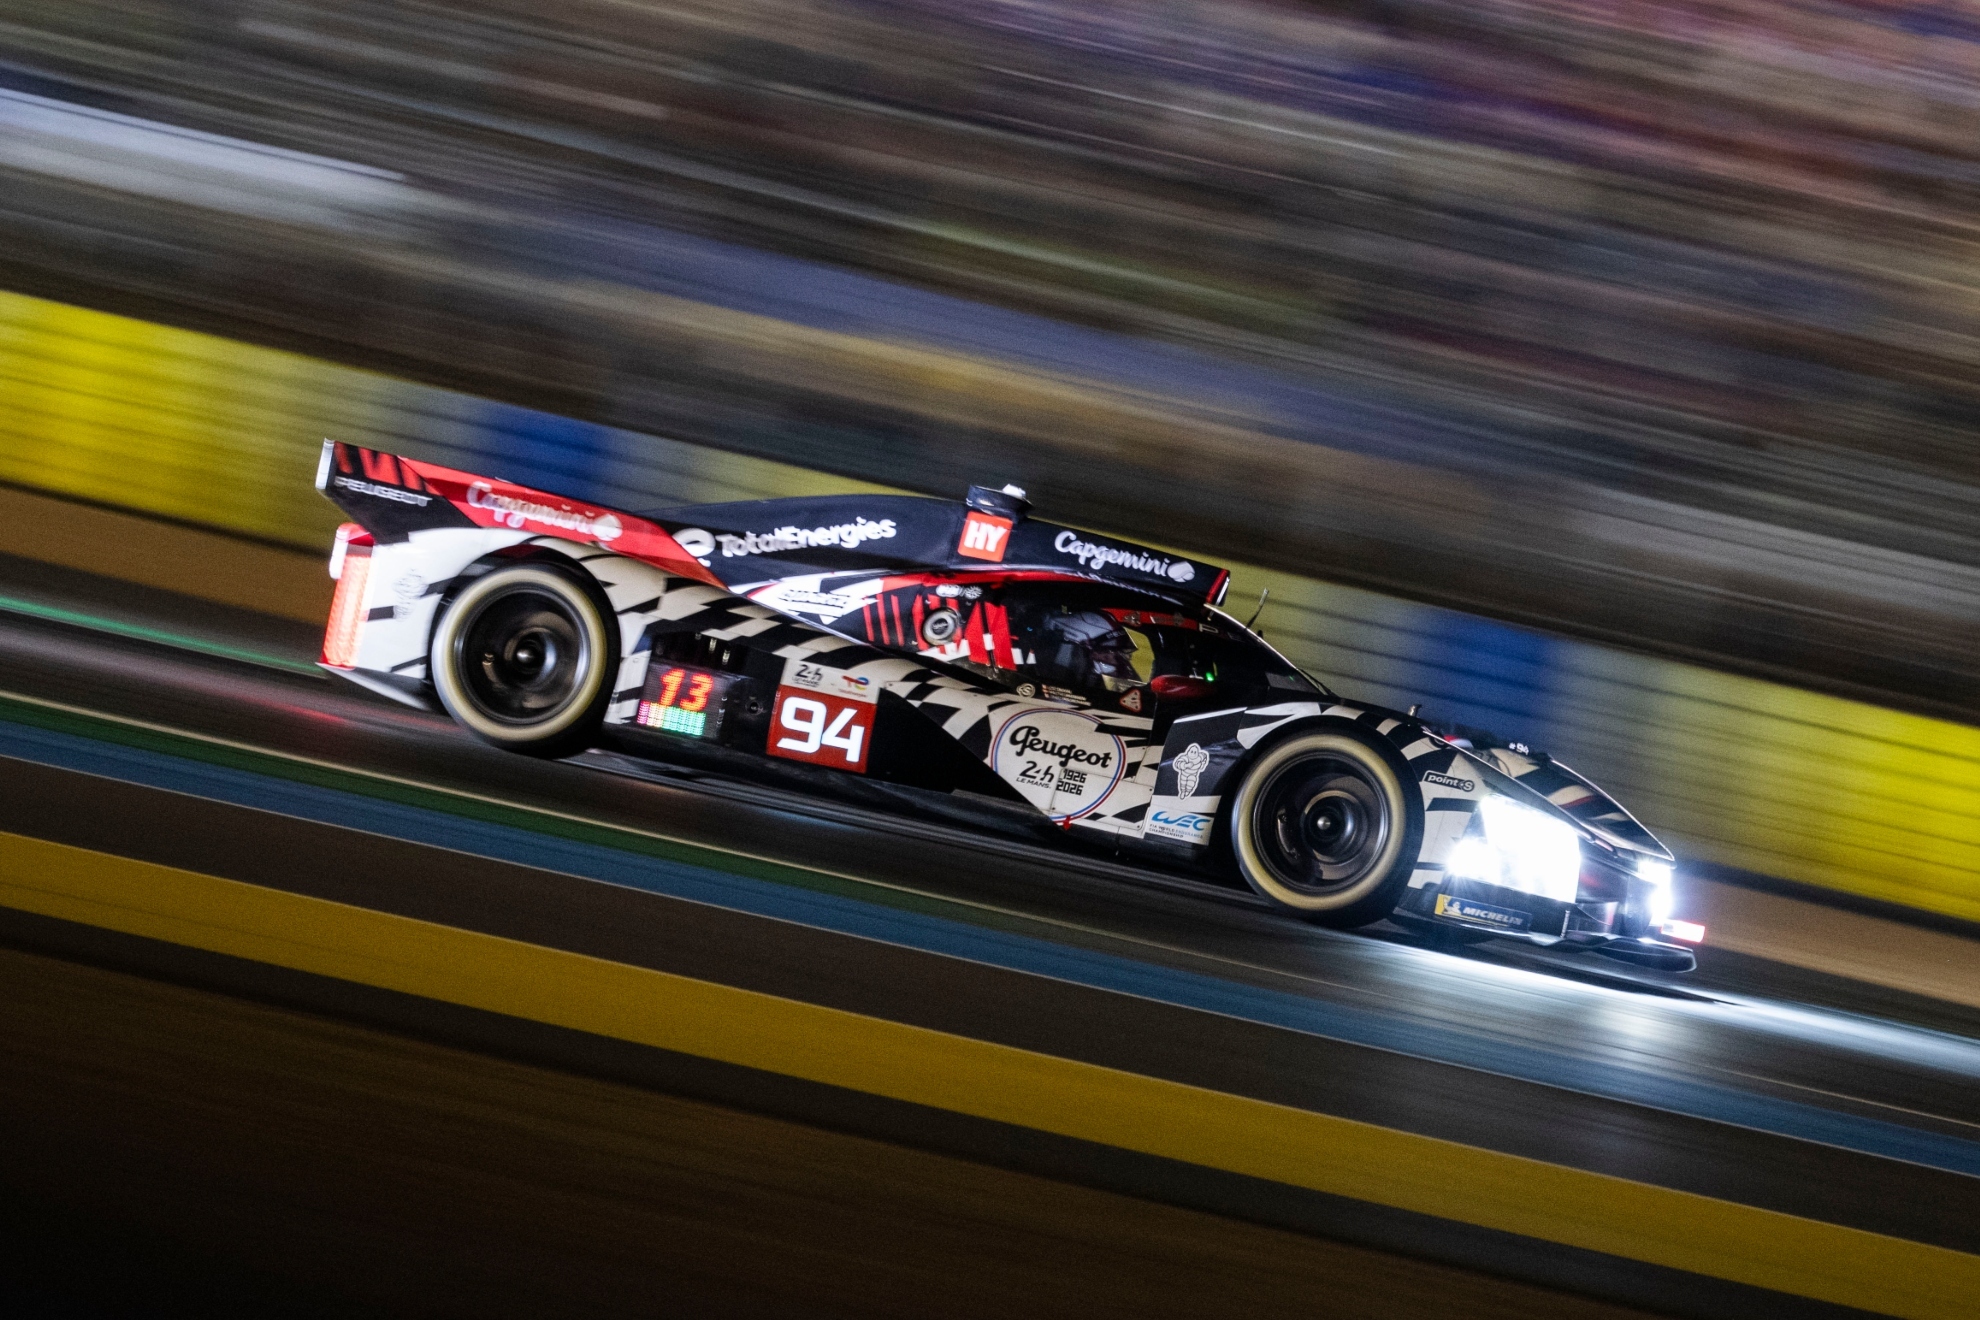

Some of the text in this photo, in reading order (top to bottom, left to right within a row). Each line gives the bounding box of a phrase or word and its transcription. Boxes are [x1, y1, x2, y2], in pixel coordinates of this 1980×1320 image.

[715, 515, 898, 558] TotalEnergies
[963, 519, 1008, 553] HY
[1054, 530, 1170, 578] Capgemini
[661, 668, 714, 713] 13
[776, 696, 866, 763] 94
[1009, 725, 1113, 769] Peugeot
[1055, 780, 1085, 796] 2026
[1062, 768, 1088, 784] 1926
[1151, 810, 1212, 831] WEC
[1463, 906, 1524, 925] MICHELIN
